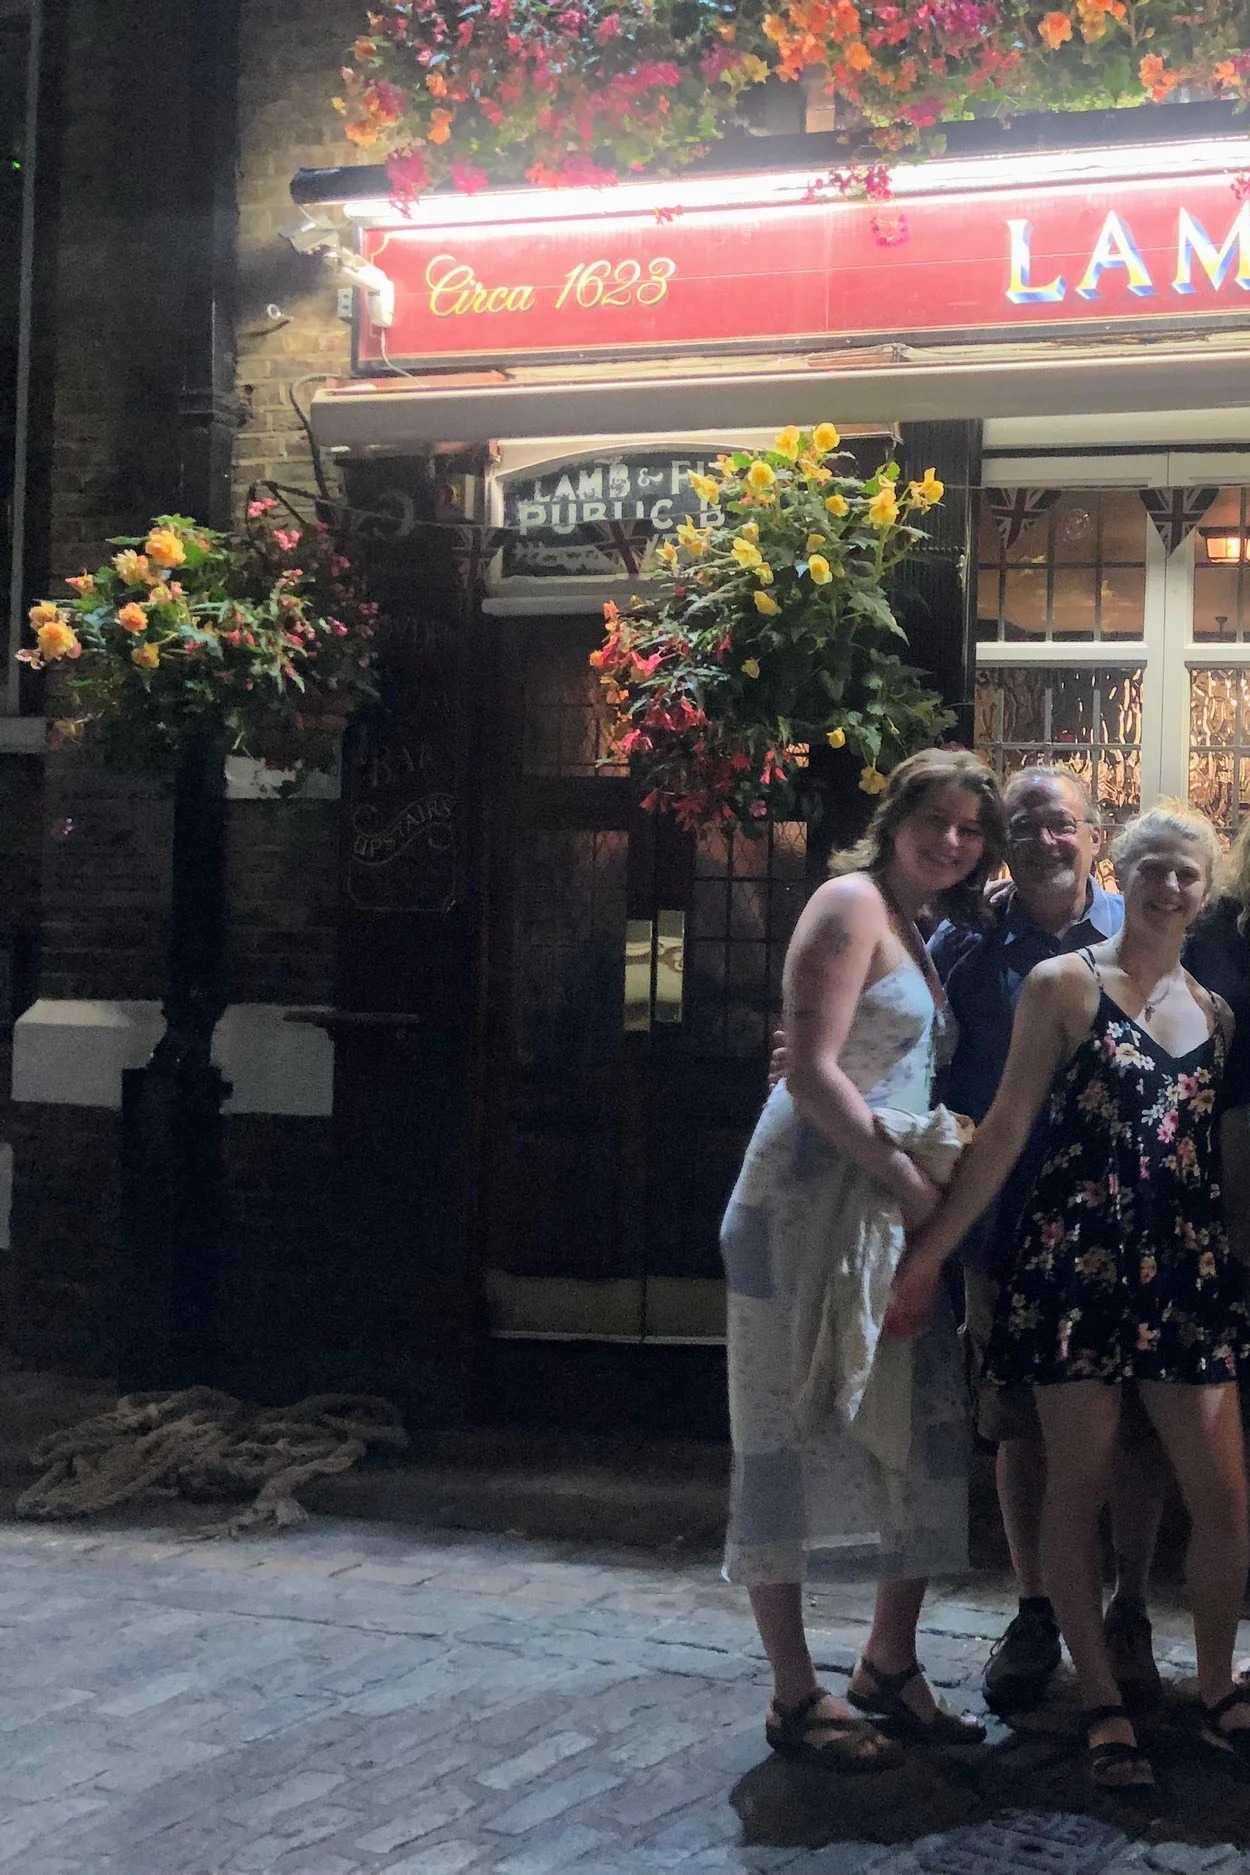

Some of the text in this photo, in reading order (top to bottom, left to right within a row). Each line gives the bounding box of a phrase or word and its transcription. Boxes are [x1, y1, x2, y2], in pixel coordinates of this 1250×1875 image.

[426, 254, 677, 317] Circa 1623
[533, 462, 632, 502] LAMB
[636, 466, 664, 489] &
[517, 498, 674, 536] PUBLIC
